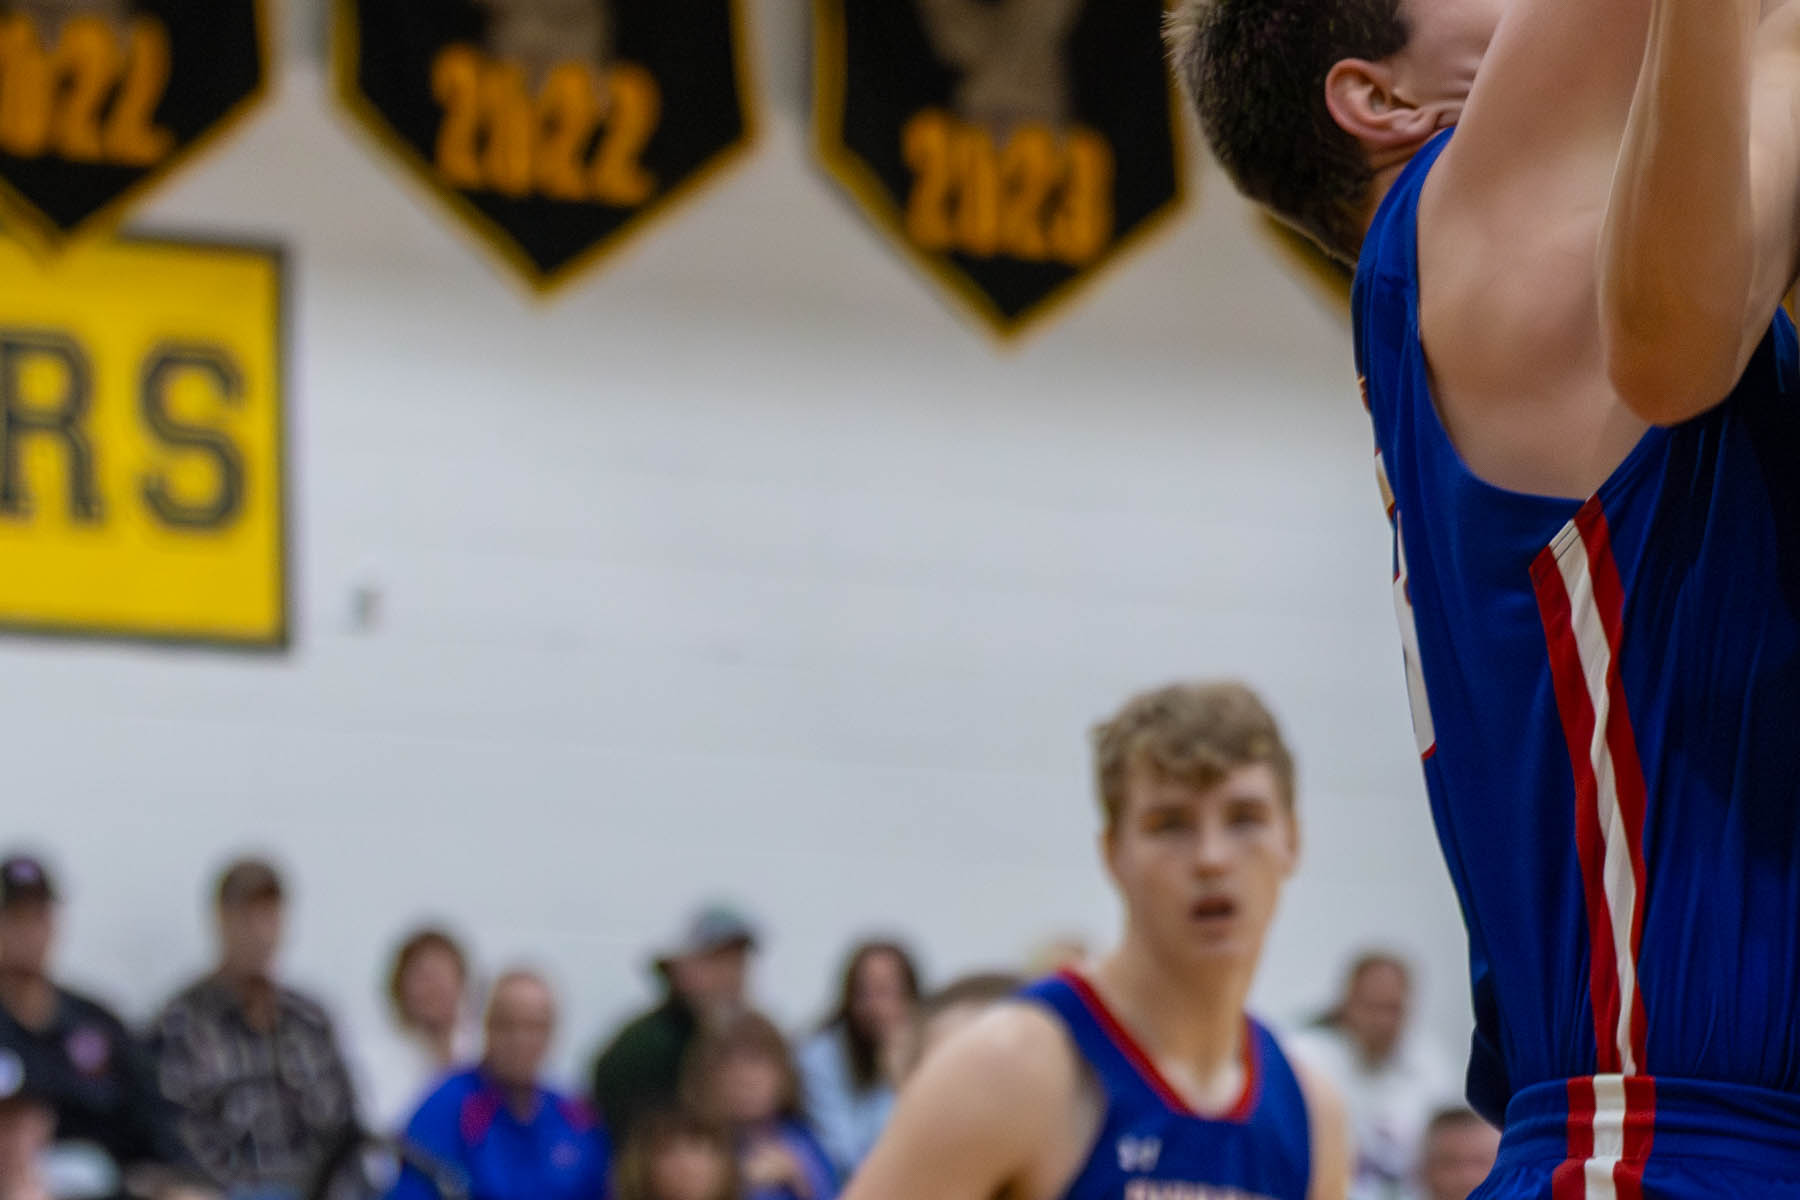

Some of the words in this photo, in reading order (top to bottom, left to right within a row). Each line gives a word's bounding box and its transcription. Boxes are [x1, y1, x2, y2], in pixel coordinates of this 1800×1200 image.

[430, 43, 662, 202] 2022
[901, 106, 1116, 264] 2023
[0, 327, 248, 534] RS
